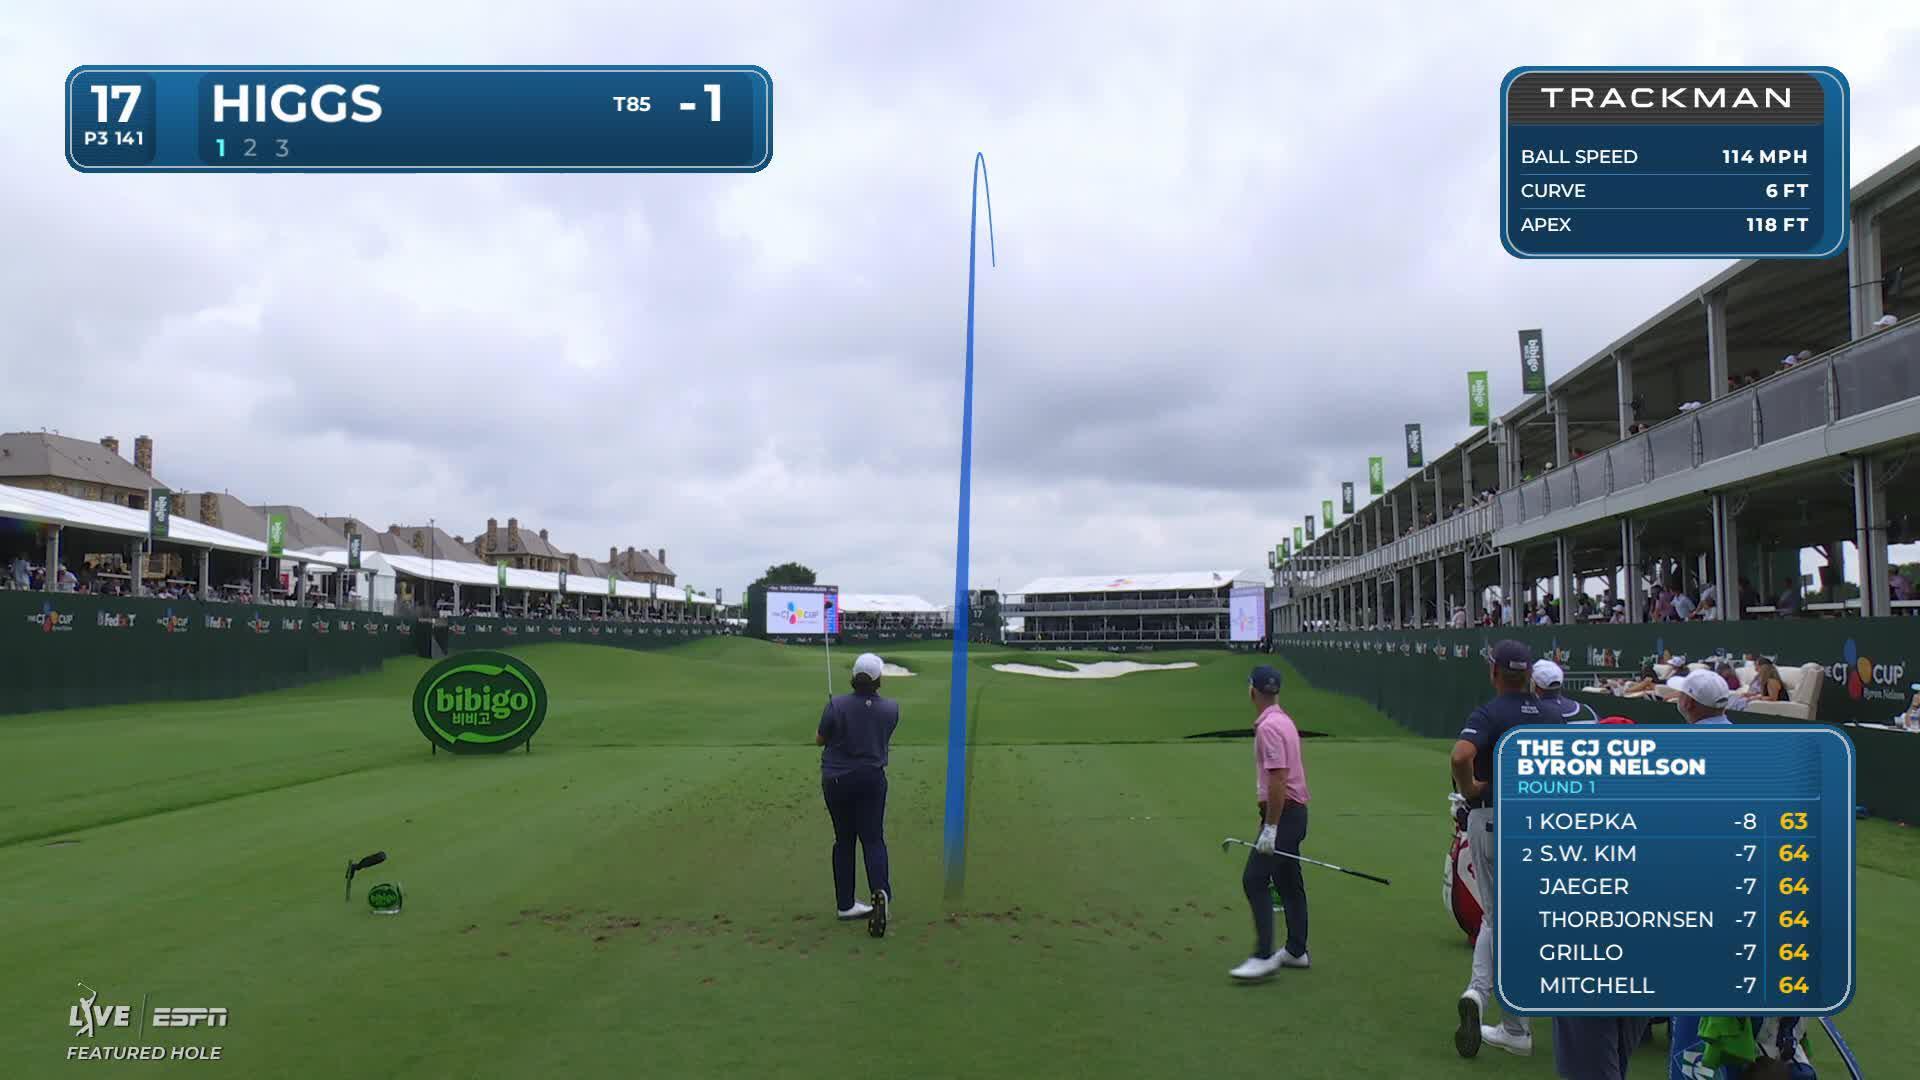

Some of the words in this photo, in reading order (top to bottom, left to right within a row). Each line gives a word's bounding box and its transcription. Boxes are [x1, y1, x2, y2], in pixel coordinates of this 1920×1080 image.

[1527, 339, 1540, 372] bibigo
[1832, 662, 1849, 685] CJ
[1872, 664, 1904, 685] CUP
[436, 685, 528, 719] bibigo
[452, 712, 491, 726] 비비고
